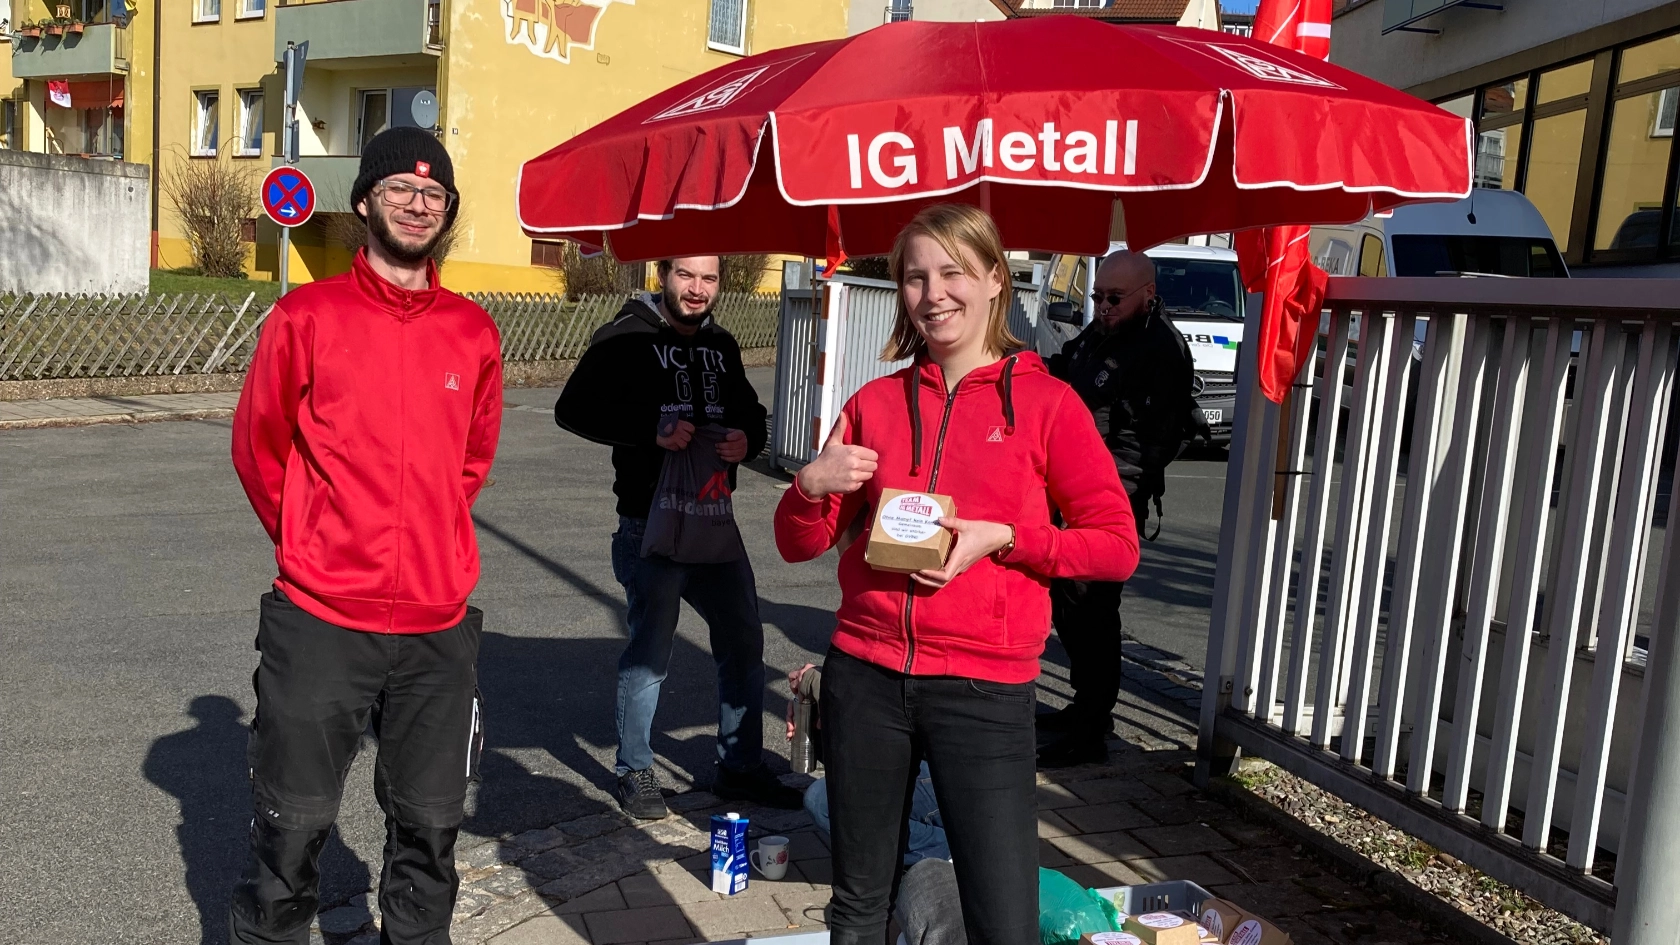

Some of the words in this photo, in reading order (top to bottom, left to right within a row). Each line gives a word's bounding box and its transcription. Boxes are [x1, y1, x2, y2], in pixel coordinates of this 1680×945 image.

[847, 131, 918, 189] IG
[943, 118, 1138, 180] Metall
[713, 844, 729, 853] Milch
